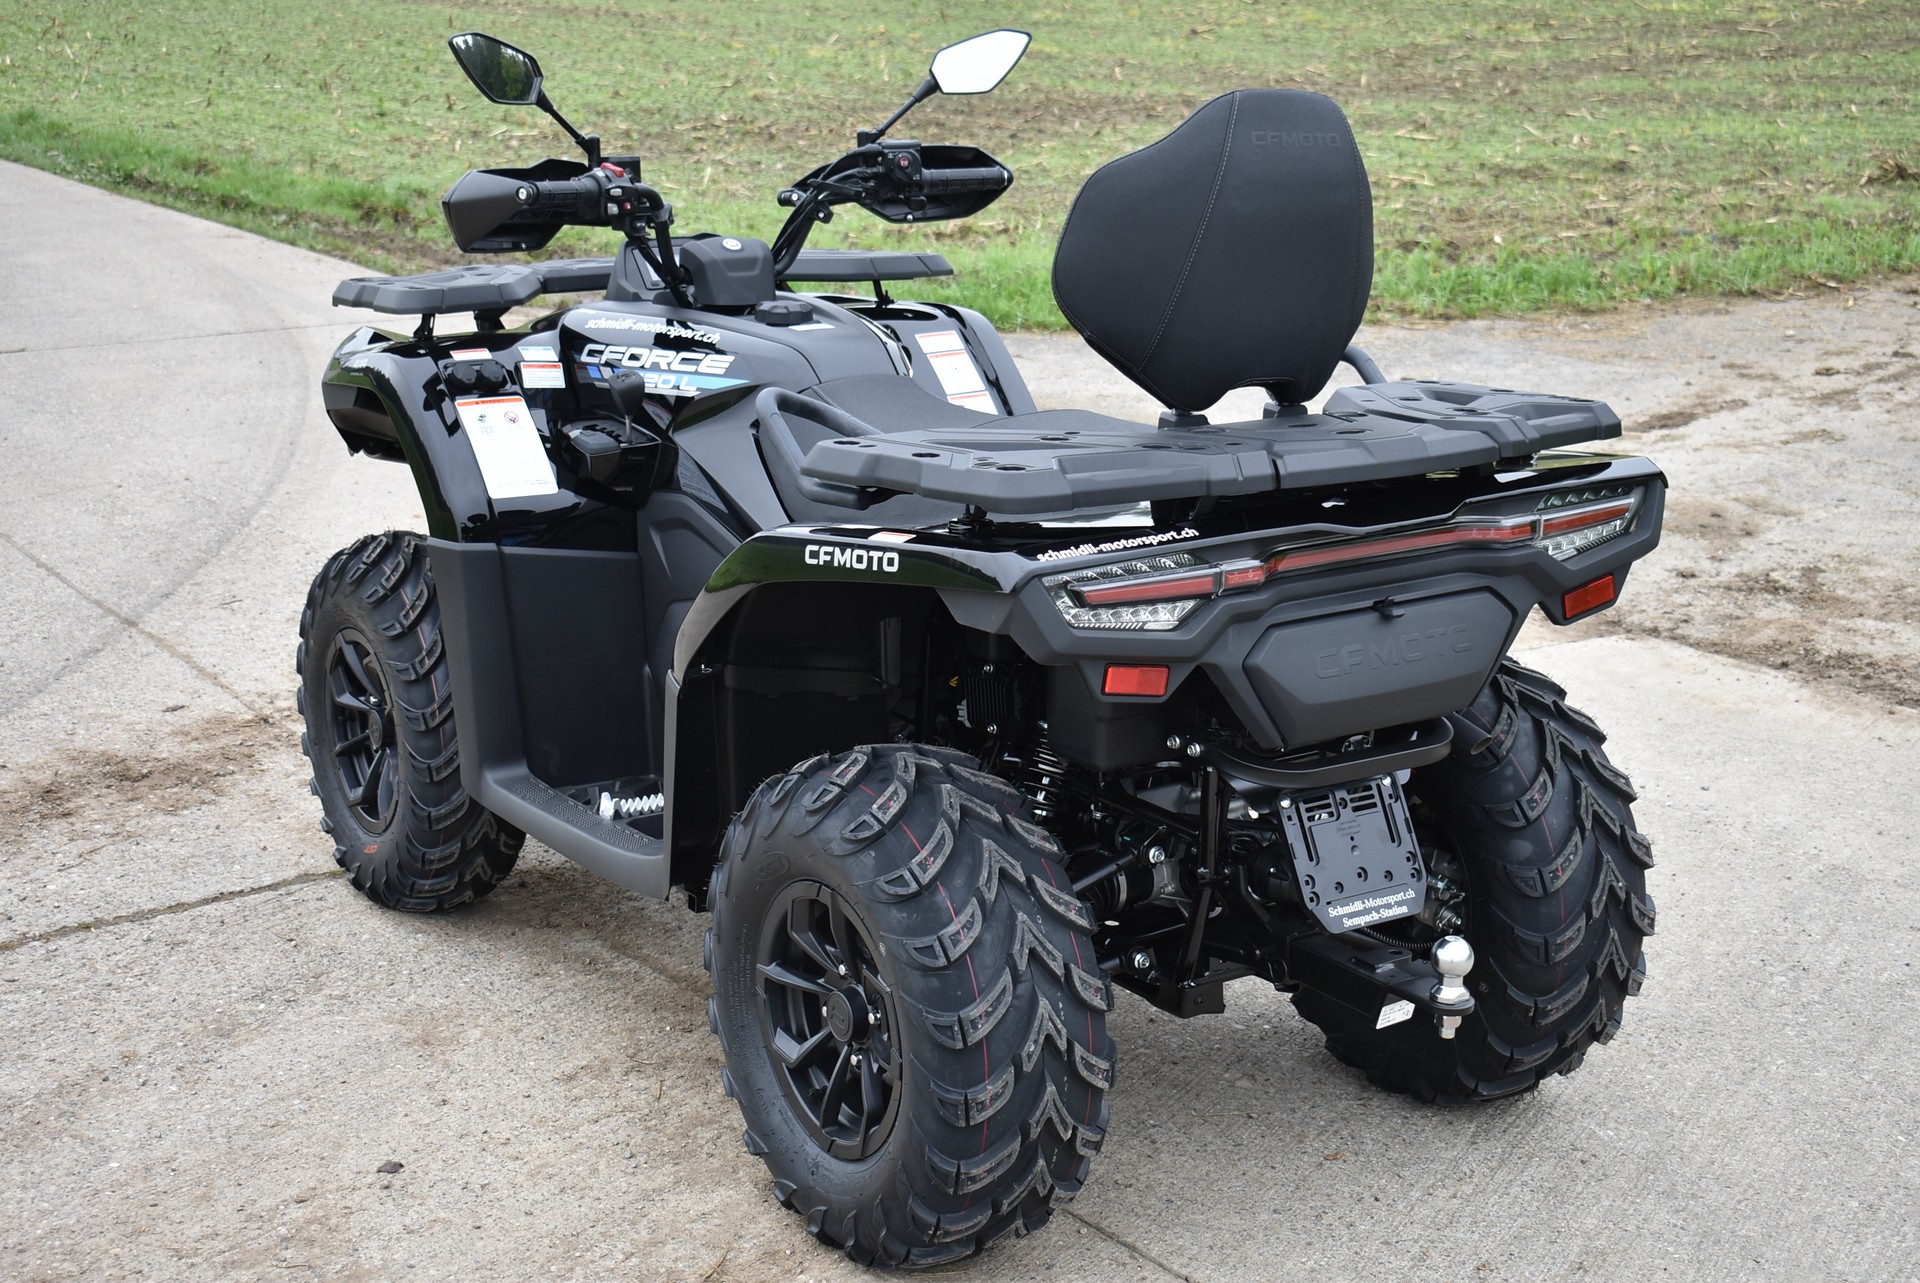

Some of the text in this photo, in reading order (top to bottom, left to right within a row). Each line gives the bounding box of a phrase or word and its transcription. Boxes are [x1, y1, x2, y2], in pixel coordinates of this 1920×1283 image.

[1251, 130, 1341, 147] CFMOTO
[584, 317, 721, 344] schmidli-motorsport.ch
[580, 343, 736, 375] CFORCE
[679, 374, 697, 391] L
[804, 544, 900, 573] CFMOTO
[1036, 527, 1200, 563] schmidli-motorsport.ch
[1312, 623, 1474, 680] CFMOTO
[1328, 888, 1416, 918] Schmidli-Motorsport.ch
[1342, 905, 1409, 928] Sempach-Station
